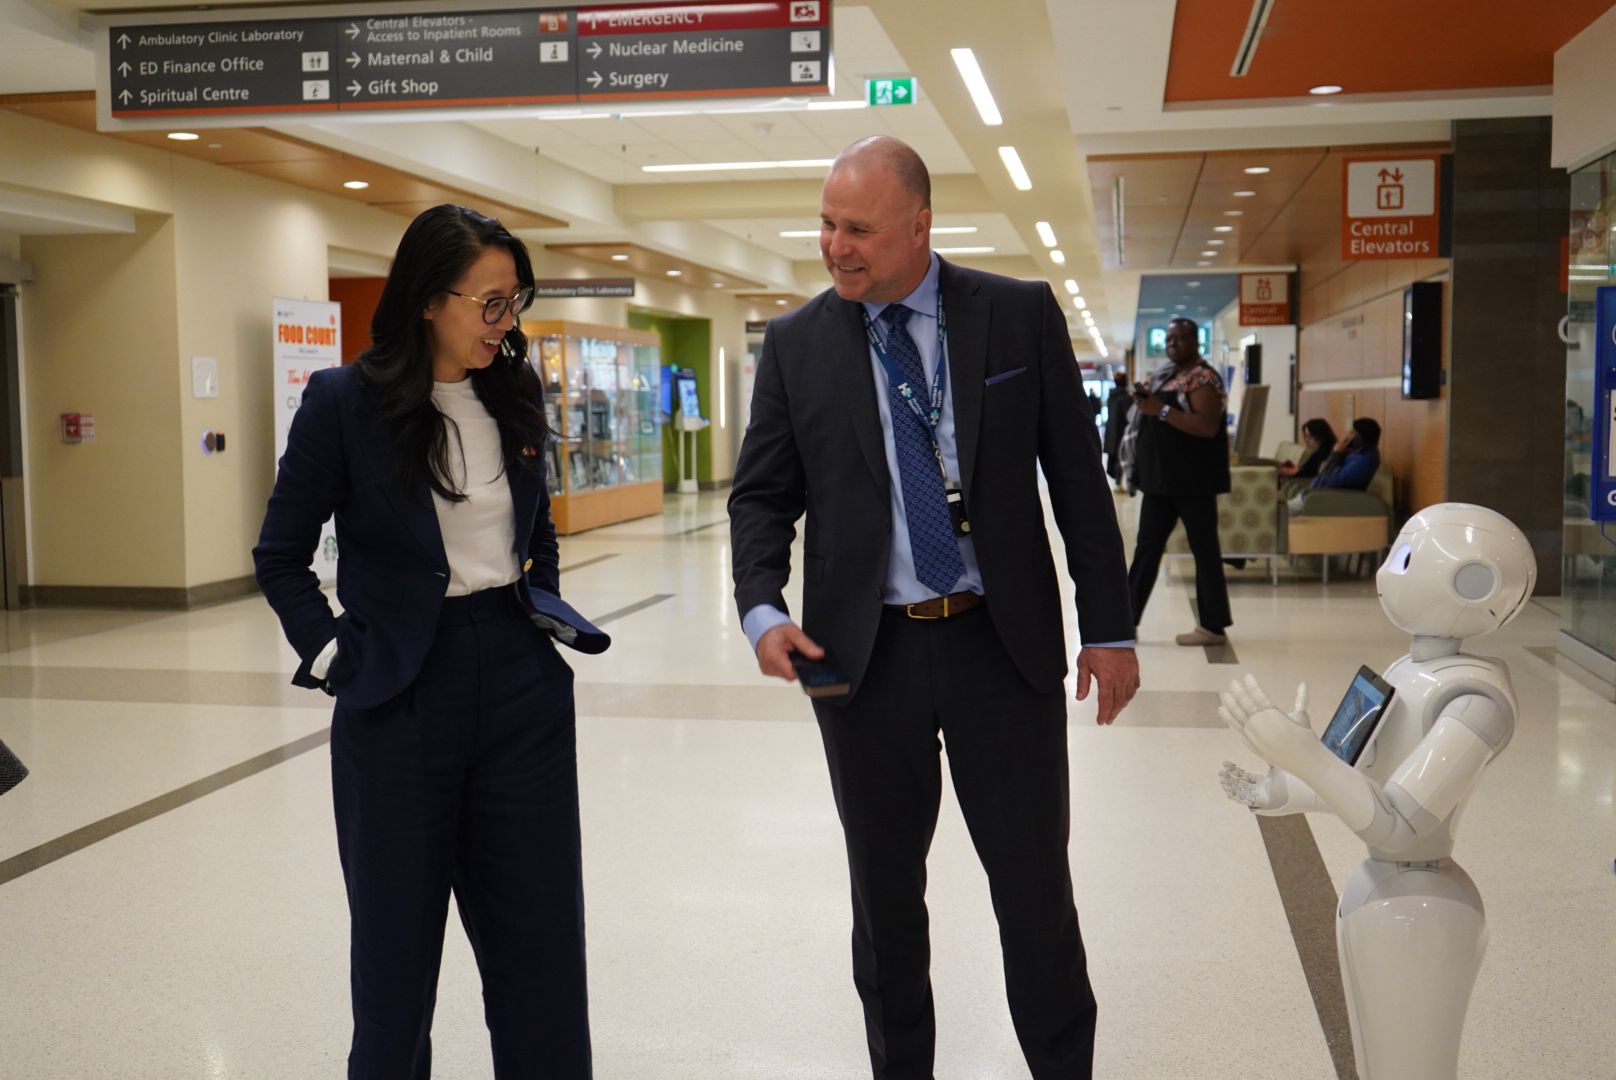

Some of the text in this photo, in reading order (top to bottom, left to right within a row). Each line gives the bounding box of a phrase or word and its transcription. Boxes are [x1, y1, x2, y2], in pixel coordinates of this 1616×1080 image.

[366, 16, 410, 30] Central
[413, 15, 465, 29] Elevators
[608, 11, 704, 28] EMERGENCY
[138, 28, 304, 48] Ambulatory Clinic Laboratory
[366, 24, 522, 43] Access to Inpatient Rooms
[366, 47, 493, 68] Maternal & Child
[609, 38, 744, 58] Nuclear Medicine
[139, 56, 264, 76] ED Finance Office
[367, 78, 439, 97] Gift Shop
[609, 71, 669, 90] Surgery
[139, 86, 250, 106] Spiritual Centre
[1350, 220, 1413, 238] Central
[1350, 237, 1430, 255] Elevators
[278, 323, 337, 346] FOOD COURT
